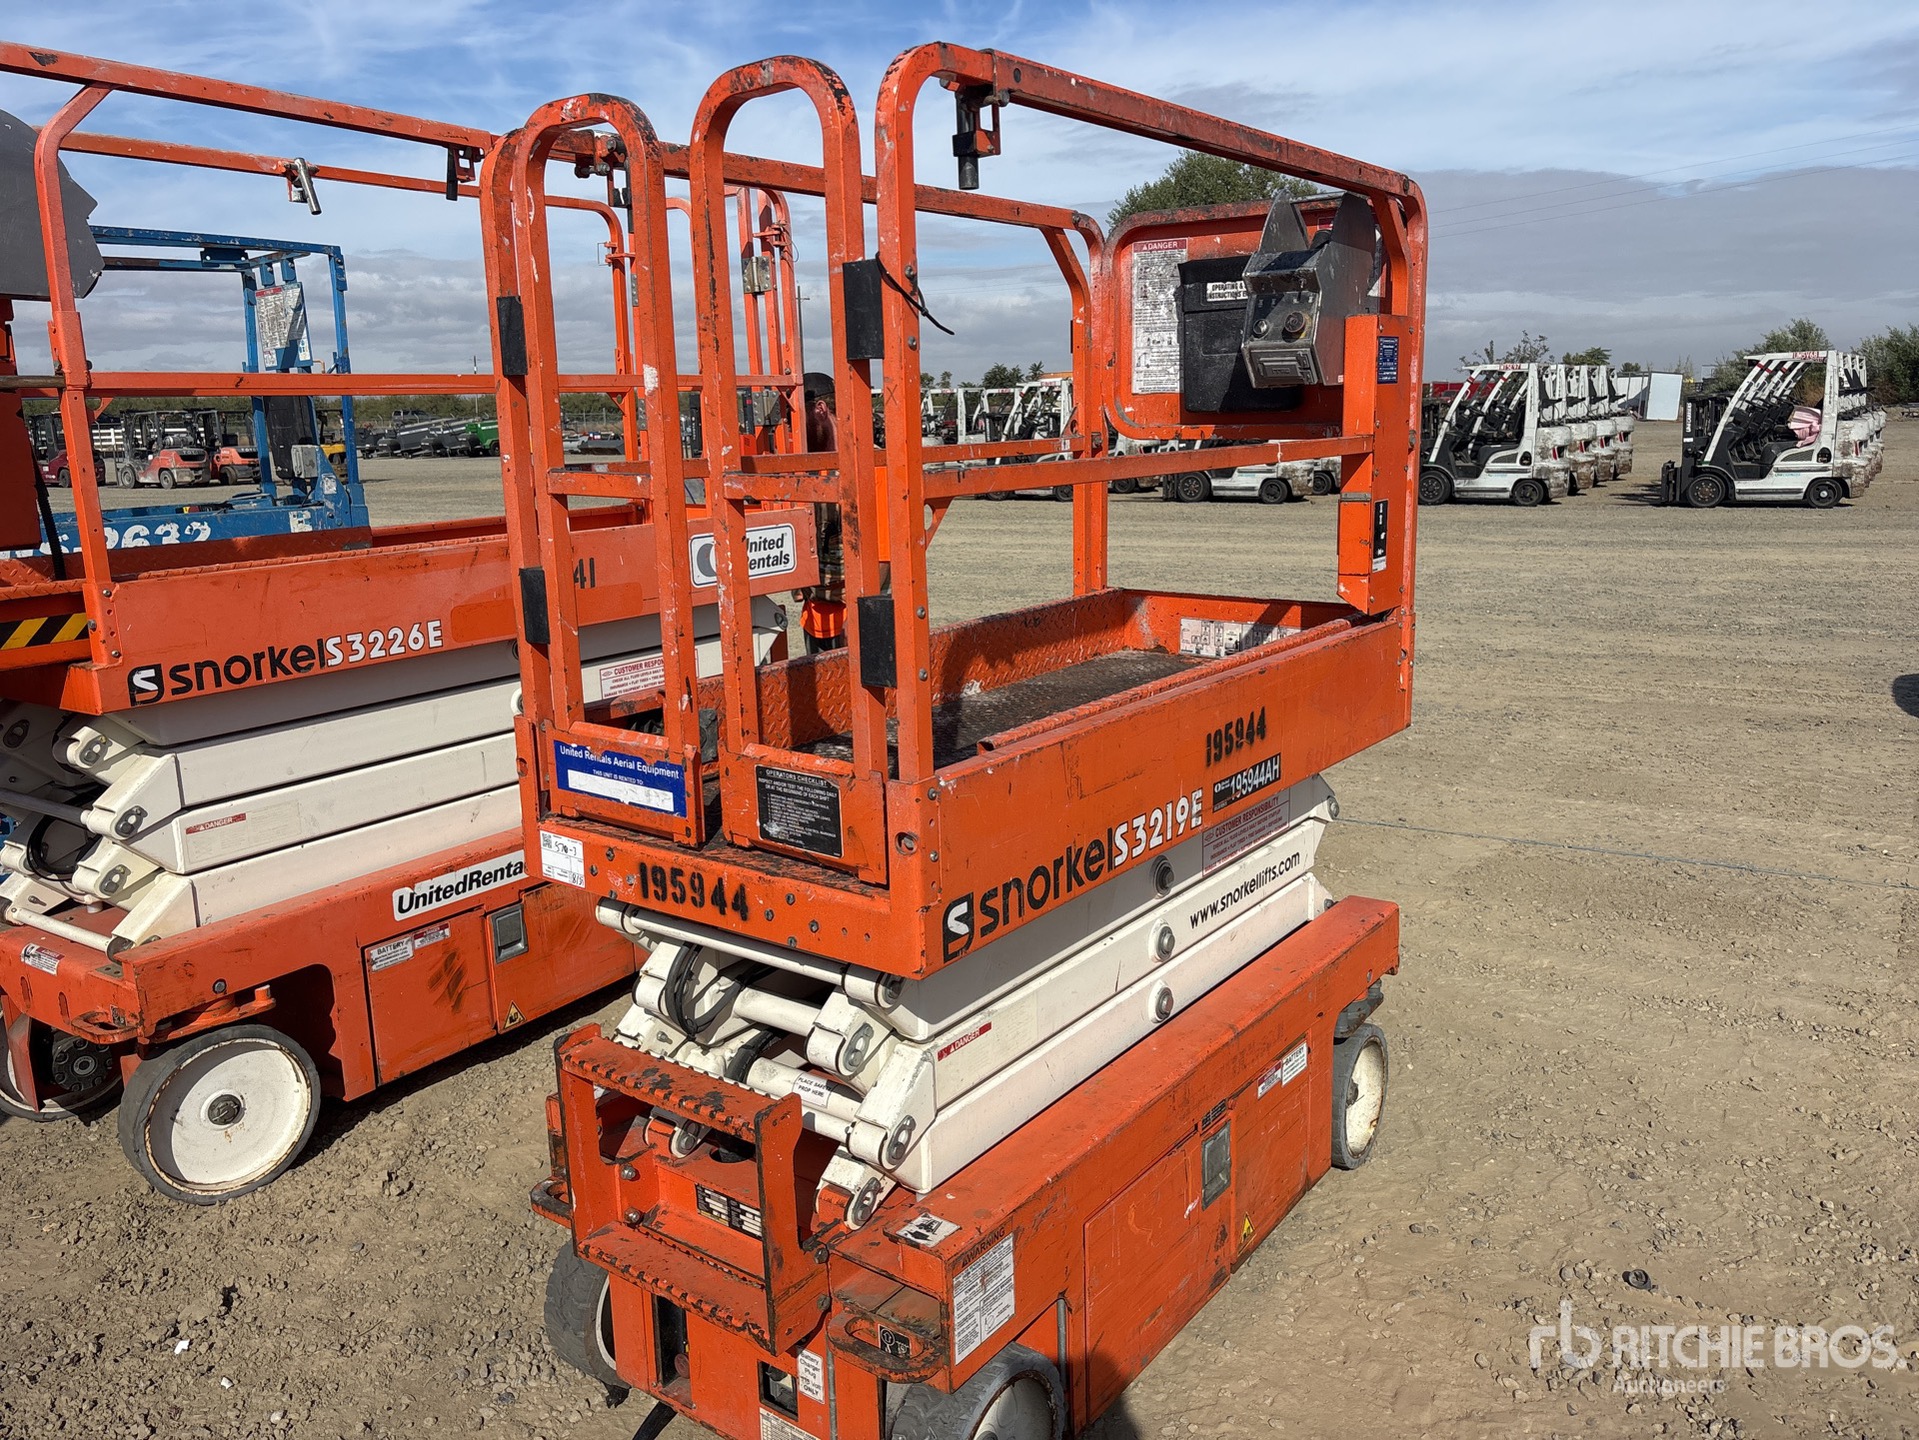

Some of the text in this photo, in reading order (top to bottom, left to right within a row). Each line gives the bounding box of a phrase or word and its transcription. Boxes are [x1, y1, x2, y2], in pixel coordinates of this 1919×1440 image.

[1148, 240, 1178, 250] DANGER
[749, 551, 790, 570] entals
[169, 638, 326, 696] snorkel
[326, 620, 444, 667] S3226E
[614, 663, 643, 676] CUSTOMER
[1206, 705, 1267, 767] 195944
[560, 745, 583, 759] United
[613, 757, 635, 770] Aerial
[637, 762, 679, 779] Equipment
[1231, 755, 1280, 800] 195944AH
[205, 817, 233, 830] DANGER
[1214, 816, 1242, 838] CUSTOMER
[1243, 797, 1279, 821] RESPONSIBILITY
[979, 827, 1113, 938] snorkel
[1114, 788, 1203, 867] S3219E
[638, 862, 748, 921] 195944
[1190, 852, 1300, 929] www.snorkellifts.com
[377, 940, 405, 955] BATTERY
[955, 1031, 980, 1049] DANGER
[967, 1227, 1006, 1265] WARNING
